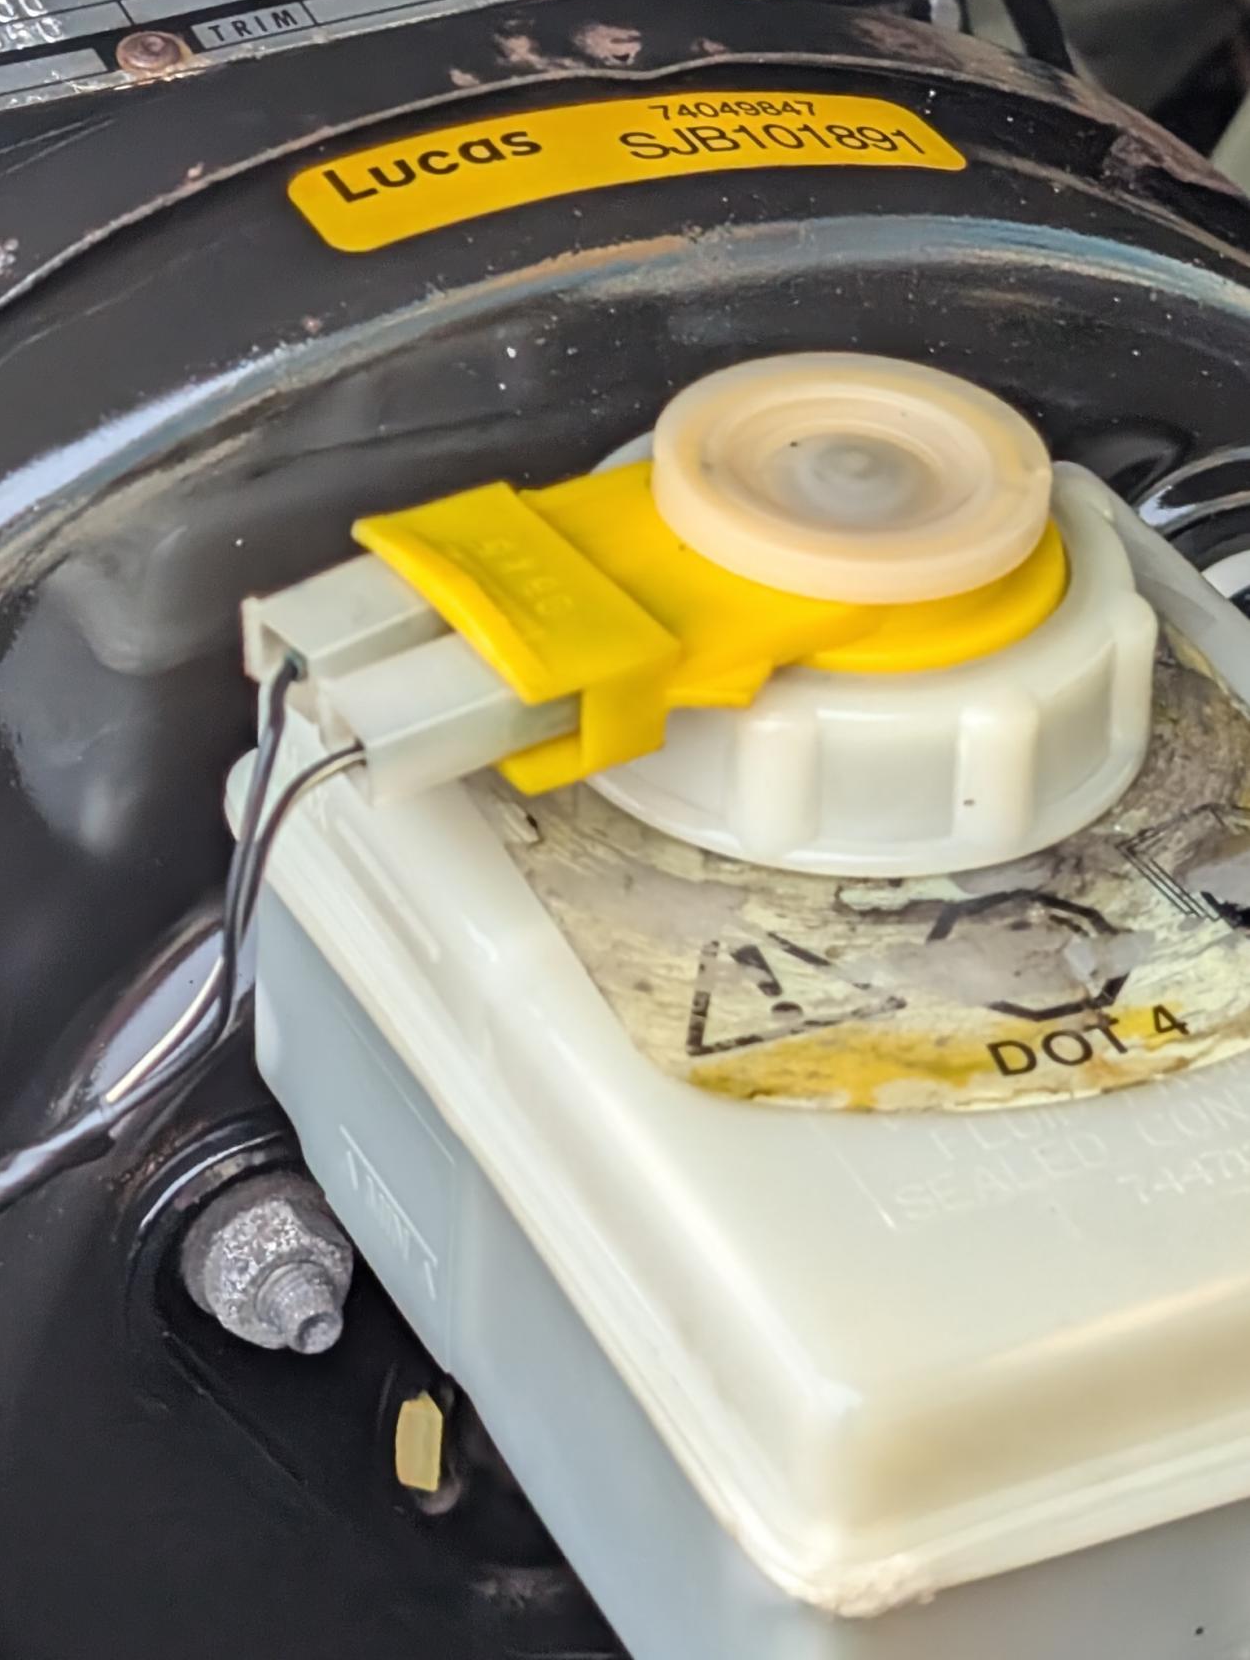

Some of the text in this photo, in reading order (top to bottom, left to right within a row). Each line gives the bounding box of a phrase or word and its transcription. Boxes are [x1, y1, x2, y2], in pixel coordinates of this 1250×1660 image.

[208, 9, 298, 42] TRIM
[648, 100, 816, 121] 74049847
[322, 123, 925, 203] Lucas SJB101891
[986, 1004, 1190, 1076] DOT 4
